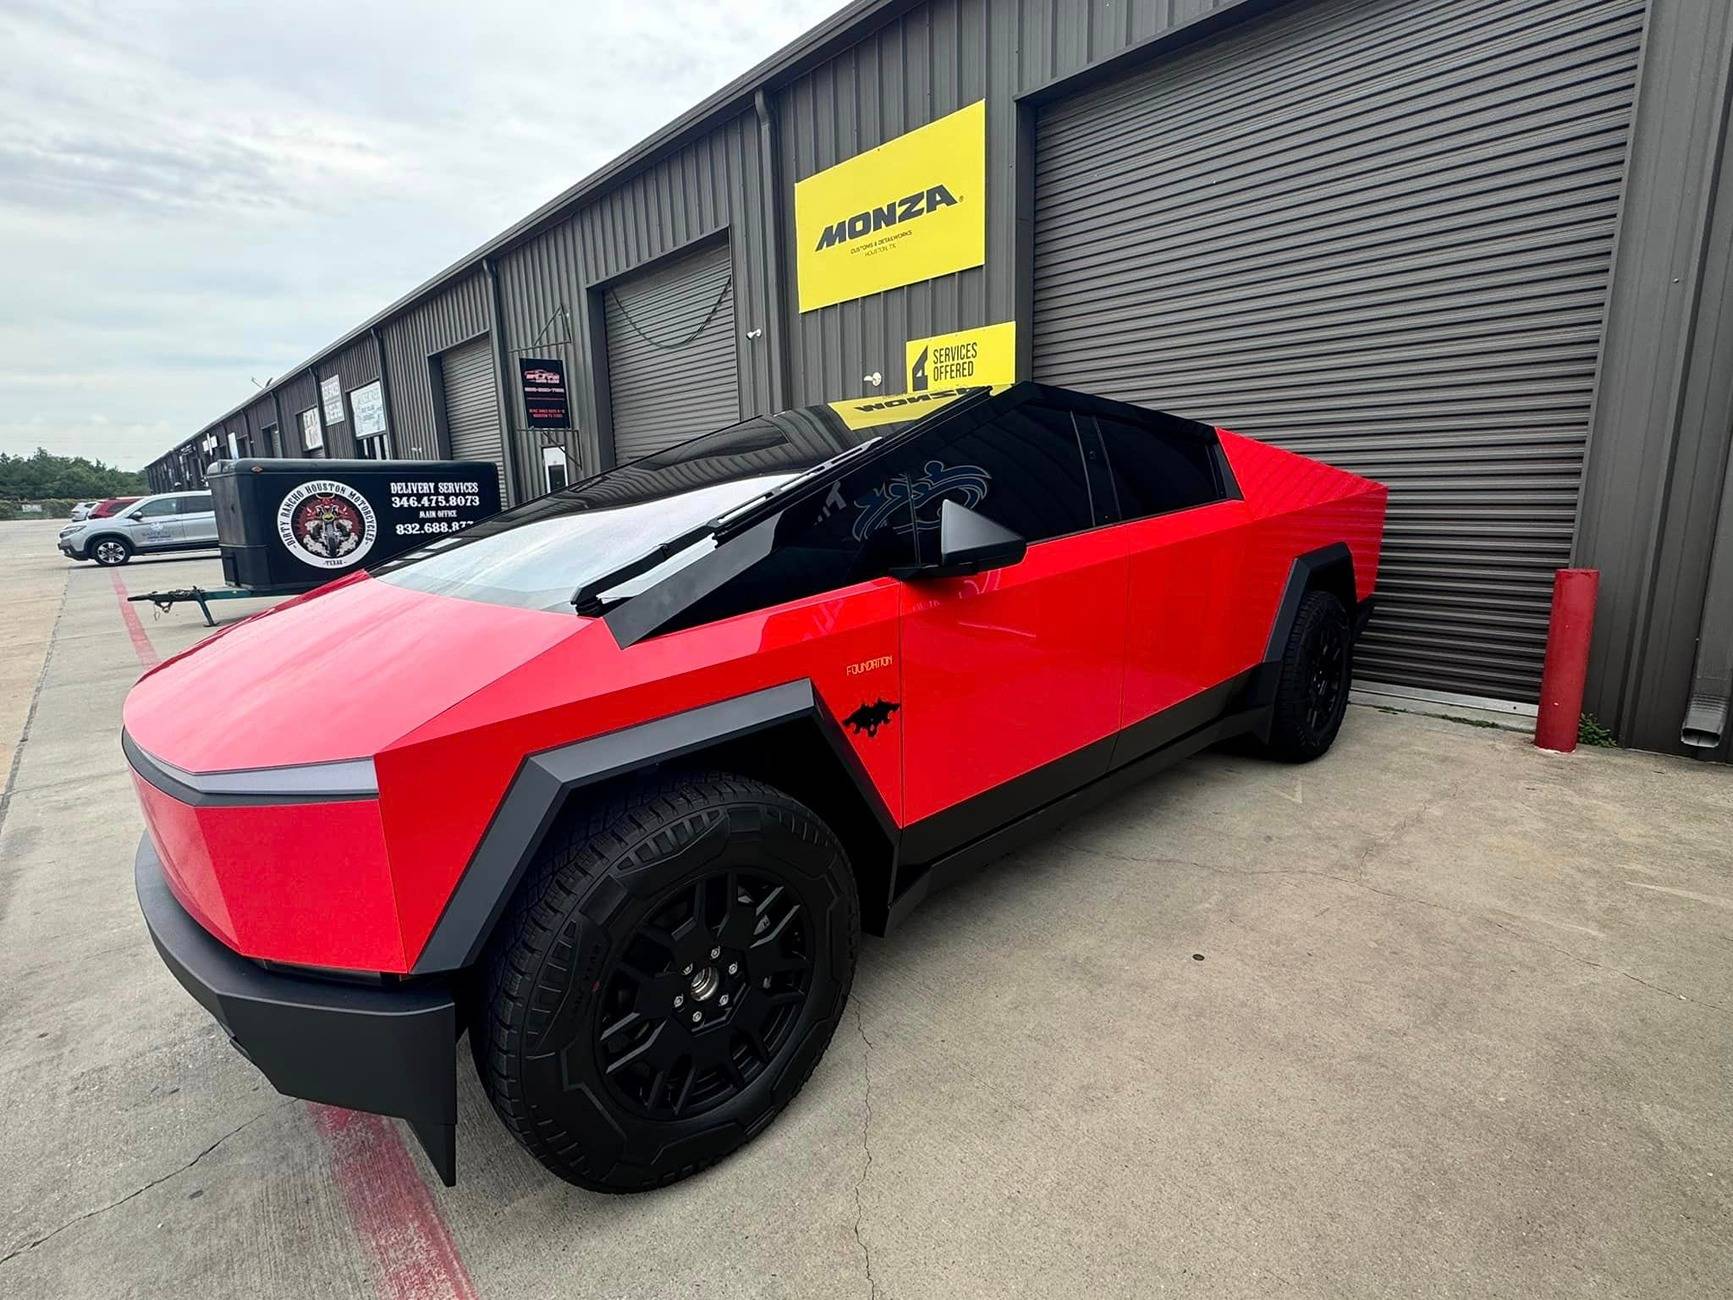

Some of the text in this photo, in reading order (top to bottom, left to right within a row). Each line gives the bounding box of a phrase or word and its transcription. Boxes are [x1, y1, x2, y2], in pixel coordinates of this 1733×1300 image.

[815, 184, 958, 252] MONZA
[850, 242, 874, 255] CUSTOMS
[933, 342, 979, 365] SERVICES
[933, 361, 975, 382] OFFERED
[390, 482, 479, 494] DELIVERY SERVICES
[391, 495, 480, 508] 346.475.8073
[280, 483, 376, 547] DIRTY RANCHO HOUSTON MOTORCYCLES
[419, 509, 457, 518] MAIN OFFICE
[846, 655, 893, 676] FOUNDATION
